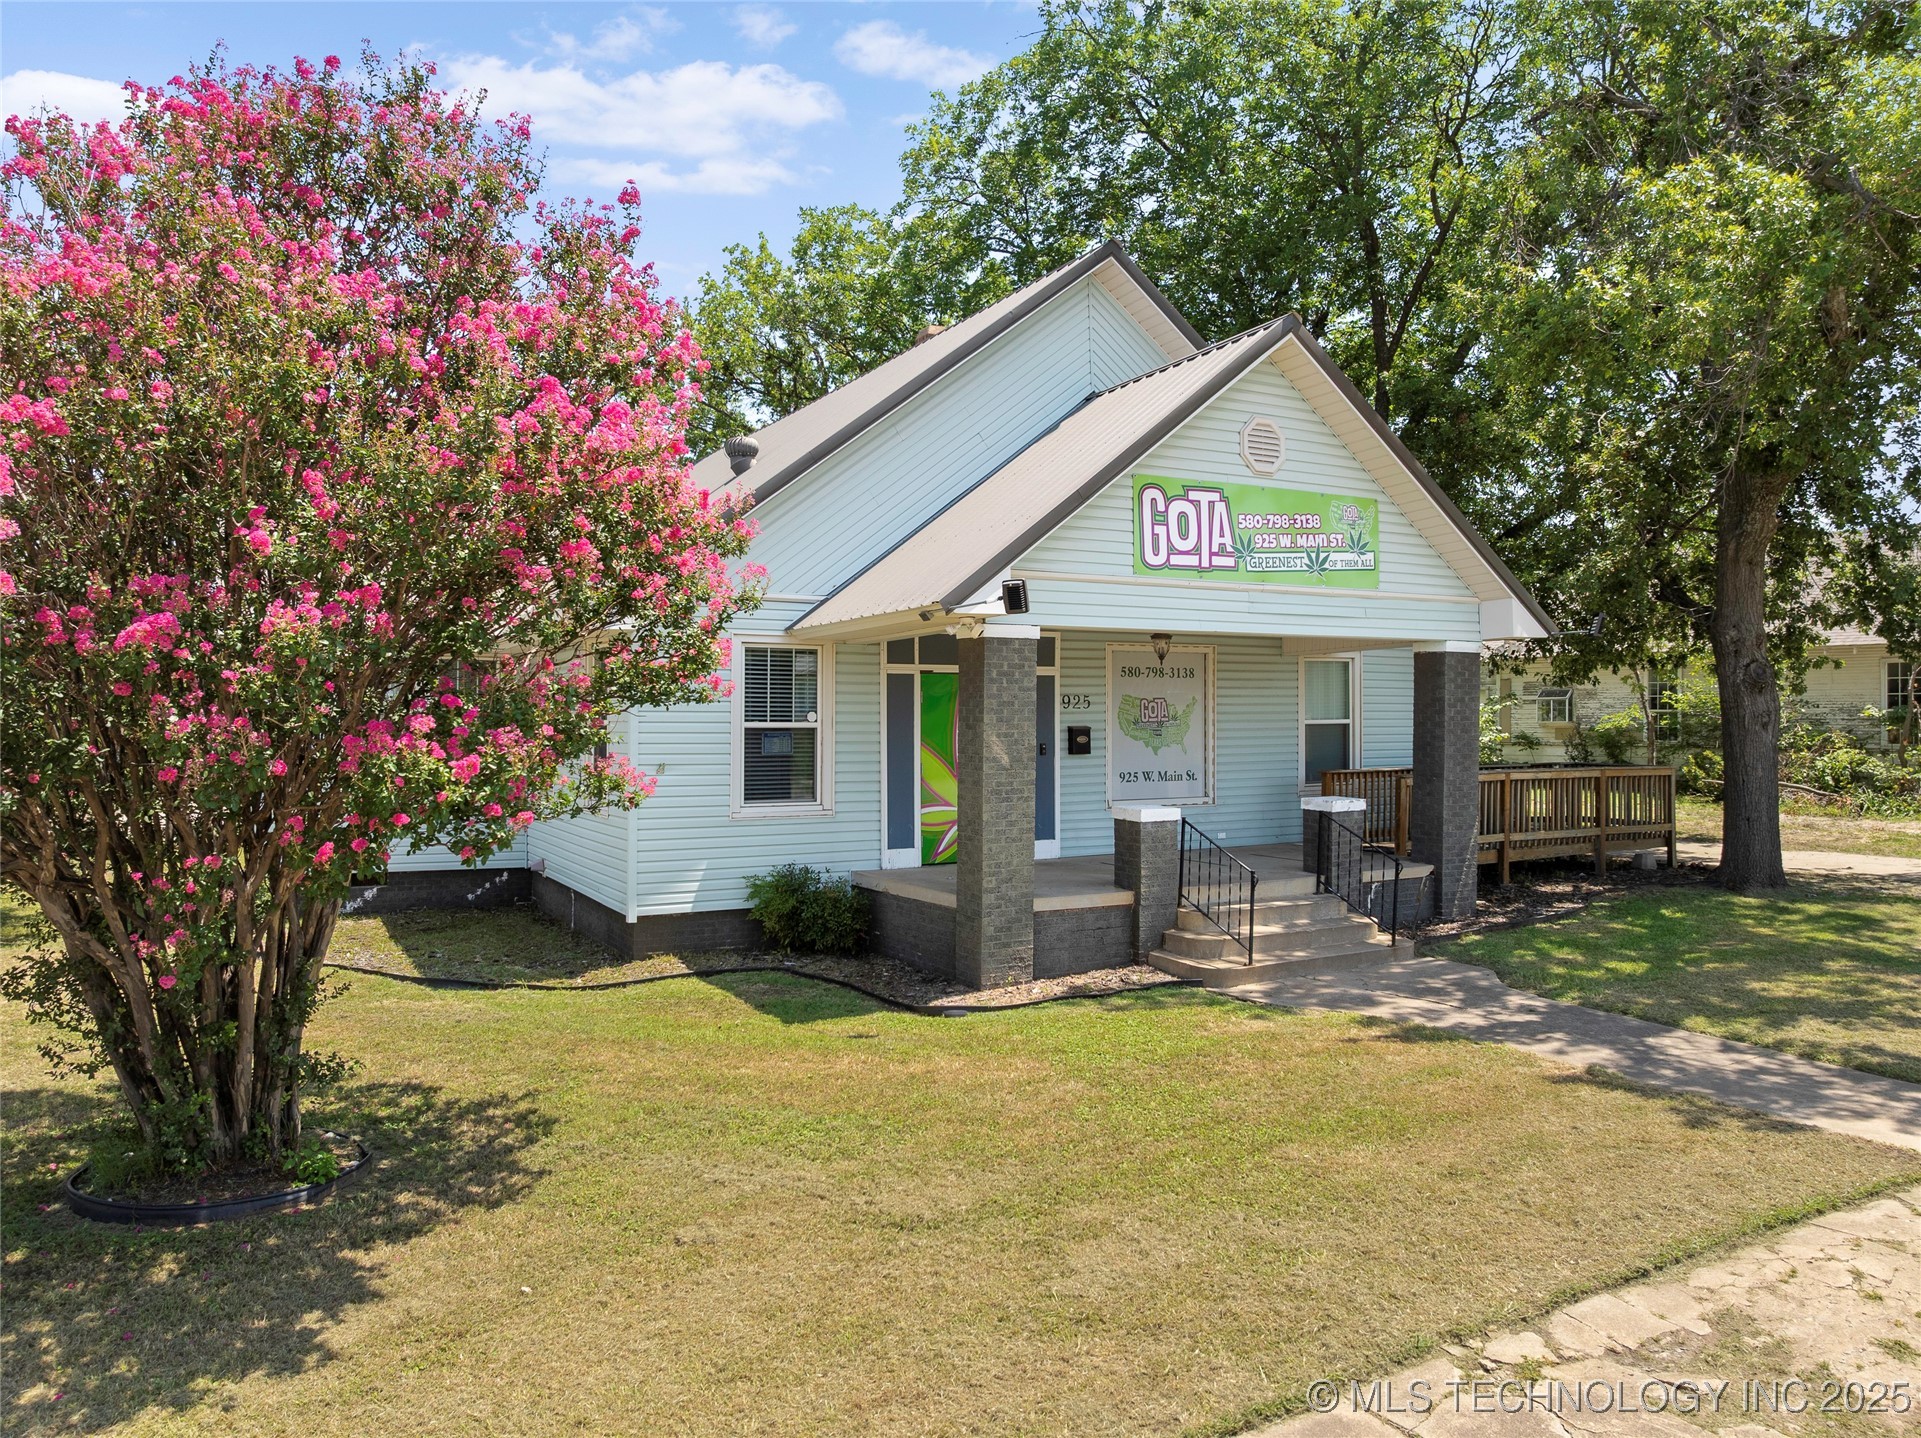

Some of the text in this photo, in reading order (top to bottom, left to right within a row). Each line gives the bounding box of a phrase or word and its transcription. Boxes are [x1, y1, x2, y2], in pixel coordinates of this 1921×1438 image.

[1237, 513, 1321, 530] 580-798-3138
[1254, 532, 1277, 549] 925
[1278, 533, 1295, 549] W.
[1329, 534, 1347, 548] ST.
[1249, 556, 1374, 571] GREENEST OF THEM ALL
[1120, 666, 1195, 679] 580-798-3138
[1061, 694, 1091, 709] 925
[1119, 769, 1198, 783] 925 W. Main St.
